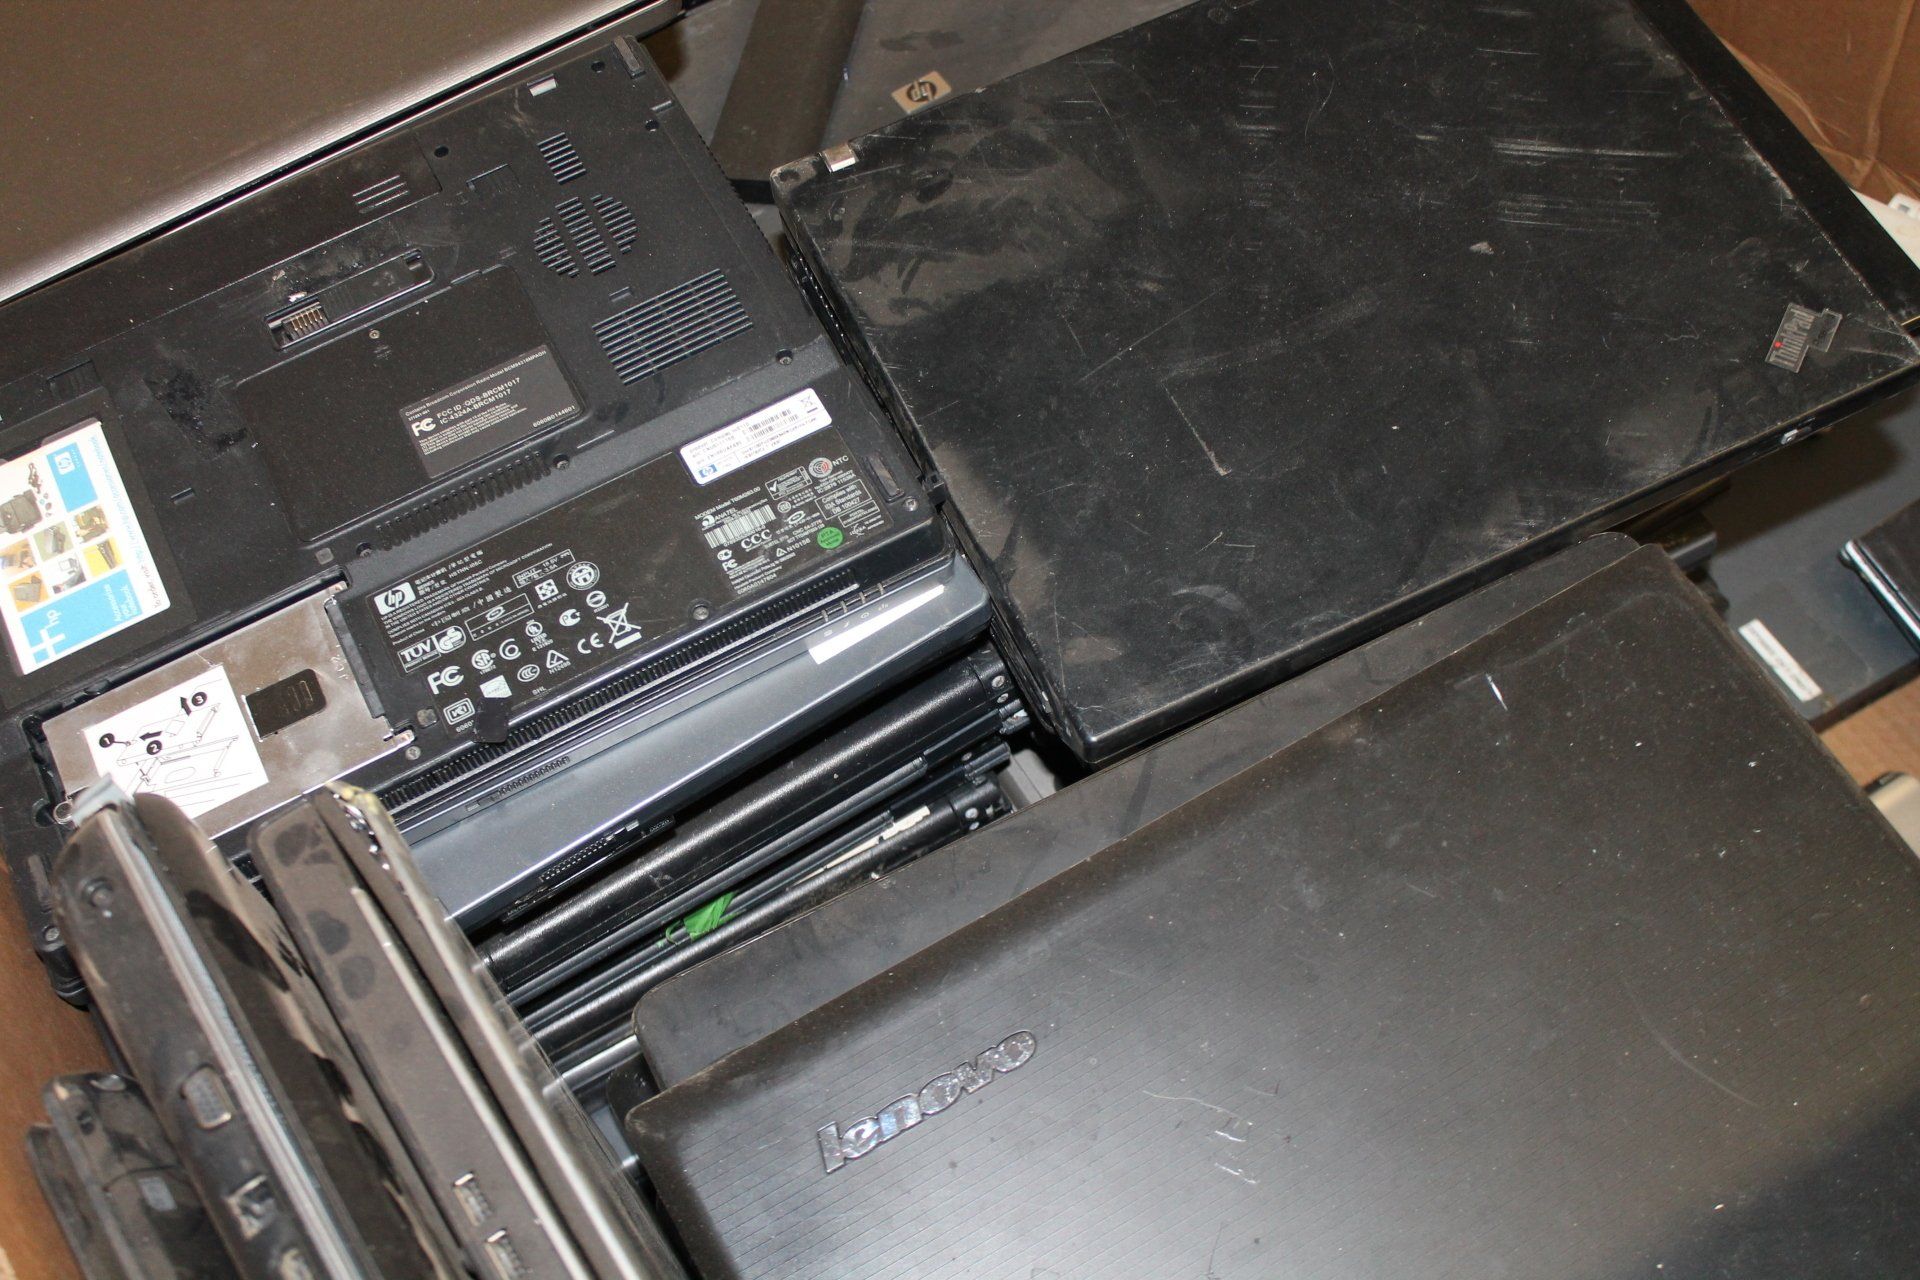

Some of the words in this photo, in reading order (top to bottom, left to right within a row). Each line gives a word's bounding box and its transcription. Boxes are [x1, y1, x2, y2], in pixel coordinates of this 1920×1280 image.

[490, 369, 504, 378] Model
[437, 408, 453, 418] FCC
[832, 455, 849, 466] NTC
[822, 490, 846, 503] Complies
[835, 490, 862, 505] Standards
[695, 507, 716, 520] MODEM
[715, 508, 738, 521] ANATEL
[741, 529, 772, 550] CCC
[517, 568, 538, 580] INPUT
[43, 606, 64, 628] hp
[577, 632, 604, 654] CE
[818, 1029, 1036, 1174] lenovo
